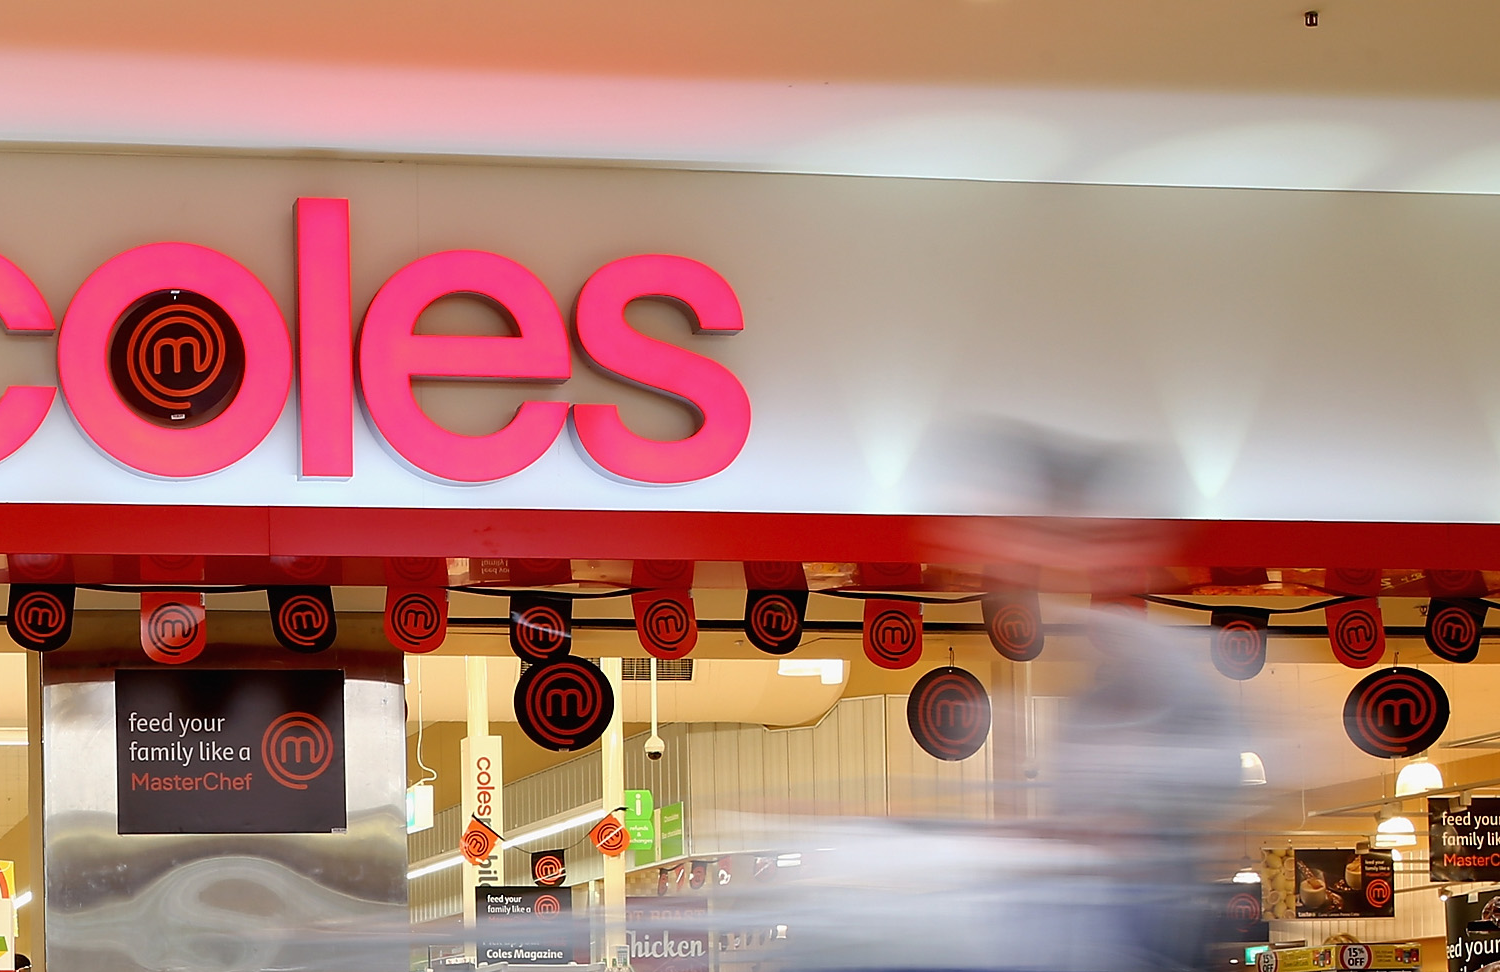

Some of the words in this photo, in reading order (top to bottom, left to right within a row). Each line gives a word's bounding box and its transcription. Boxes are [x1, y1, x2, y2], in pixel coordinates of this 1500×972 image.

[129, 712, 173, 732] feed
[179, 715, 225, 737] your
[129, 741, 194, 767] family
[200, 741, 233, 761] like
[239, 747, 251, 761] a
[131, 772, 252, 791] MasterChef
[476, 756, 495, 816] coles
[1442, 811, 1471, 826] feed
[1442, 831, 1484, 850] family
[1443, 853, 1500, 867] MasterC
[487, 894, 504, 903] feed
[505, 895, 522, 905] your
[487, 904, 511, 915] family
[512, 904, 525, 914] like
[486, 949, 513, 959] Coles
[514, 949, 564, 961] Magazine
[1347, 947, 1365, 957] 15%
[1465, 938, 1500, 962] your
[1348, 957, 1365, 967] OFF
